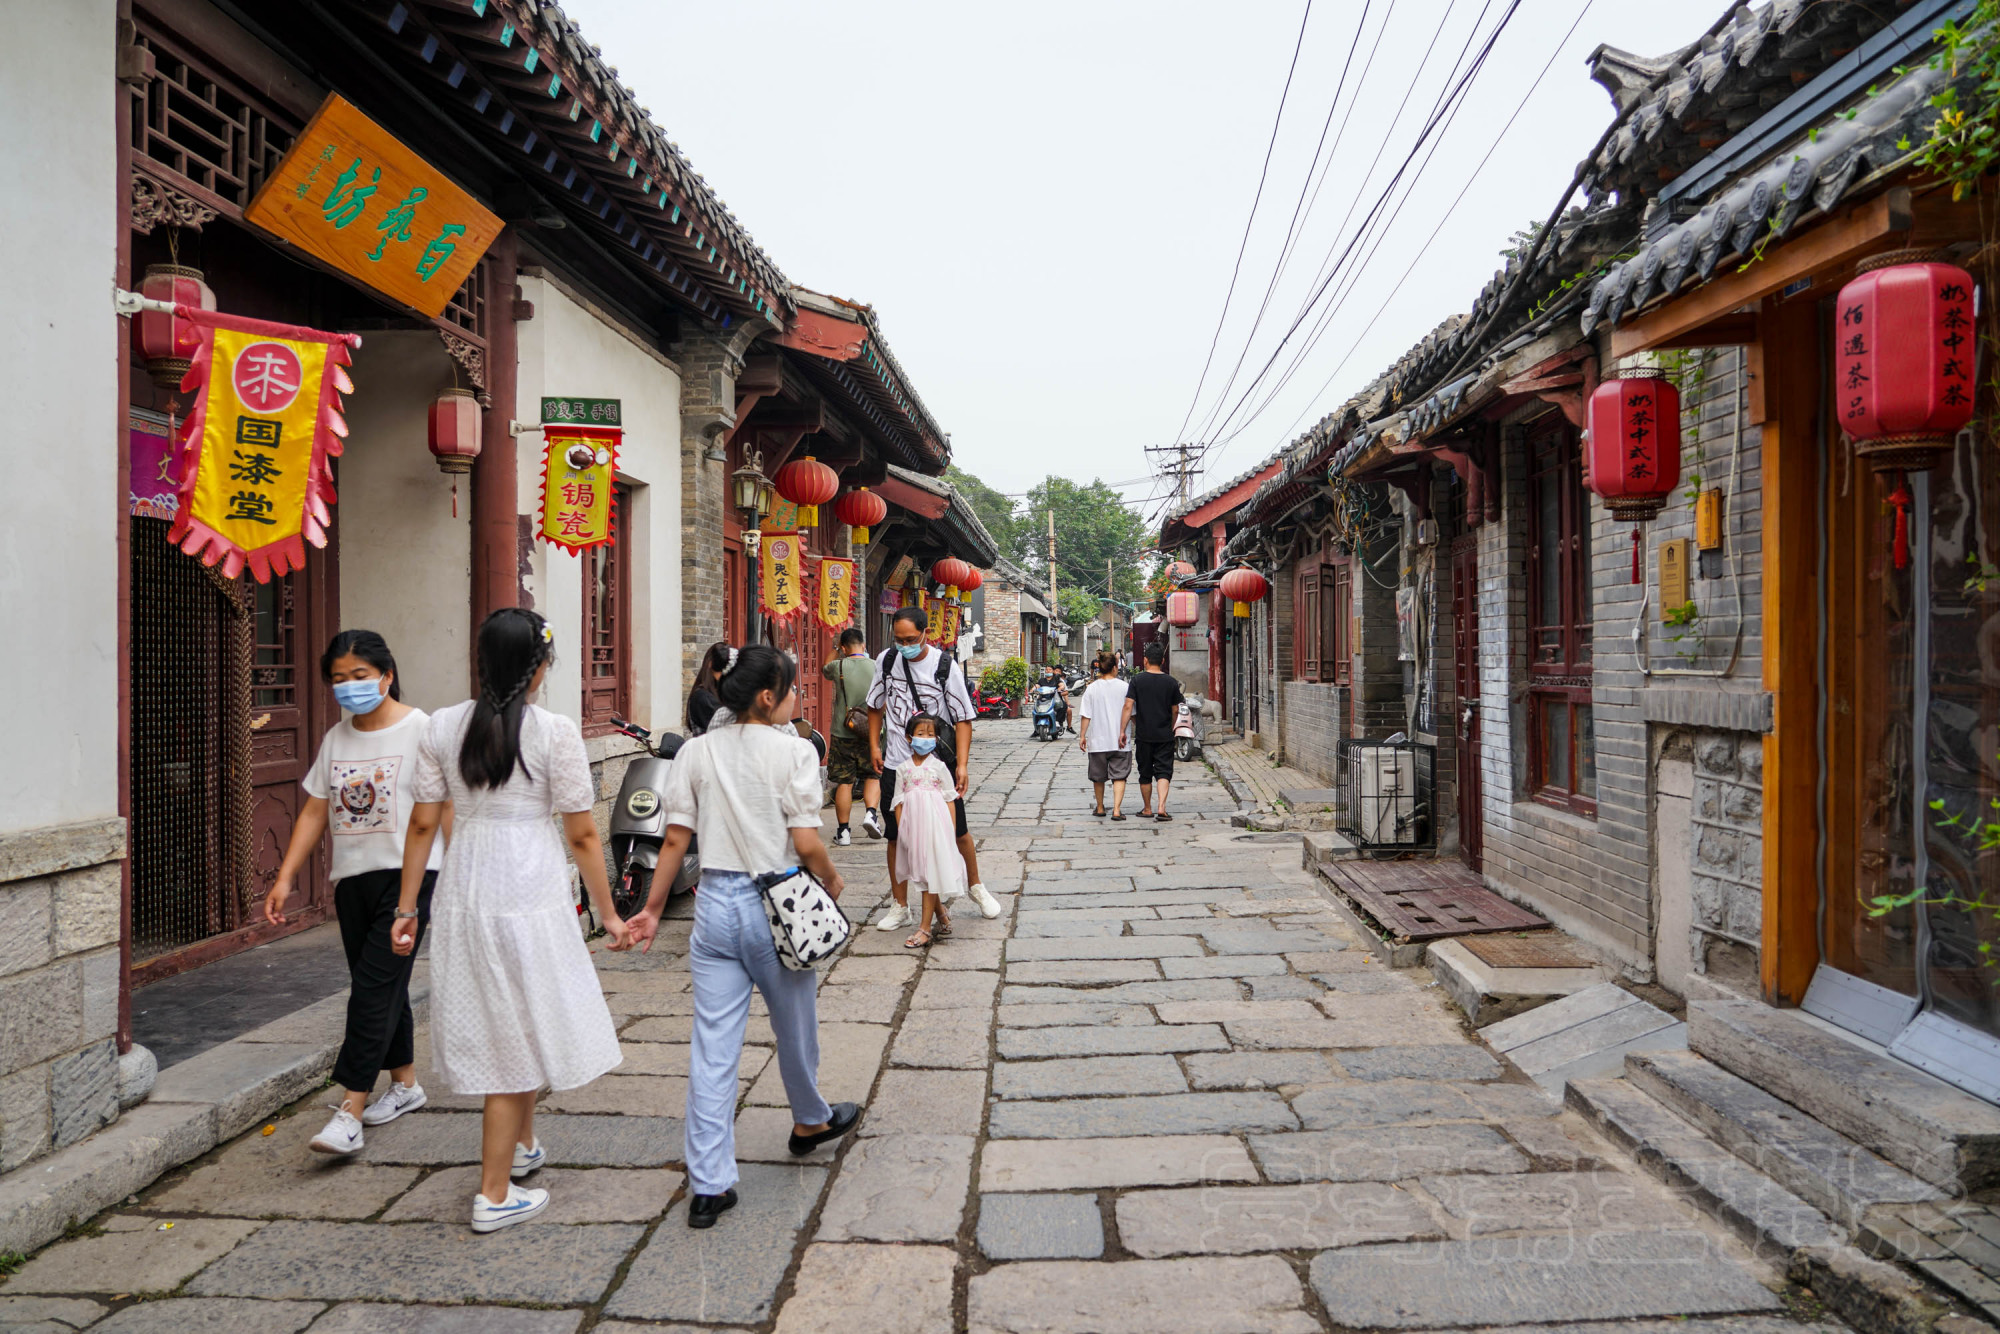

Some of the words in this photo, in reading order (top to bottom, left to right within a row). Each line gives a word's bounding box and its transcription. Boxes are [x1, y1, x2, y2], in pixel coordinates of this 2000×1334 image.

[1843, 304, 1870, 418] 佰遇茶品
[1939, 282, 1971, 407] 奶茶中式茶
[226, 415, 284, 526] 国漆堂
[1627, 395, 1655, 479] 奶茶中式茶
[774, 563, 789, 605] 兔子王
